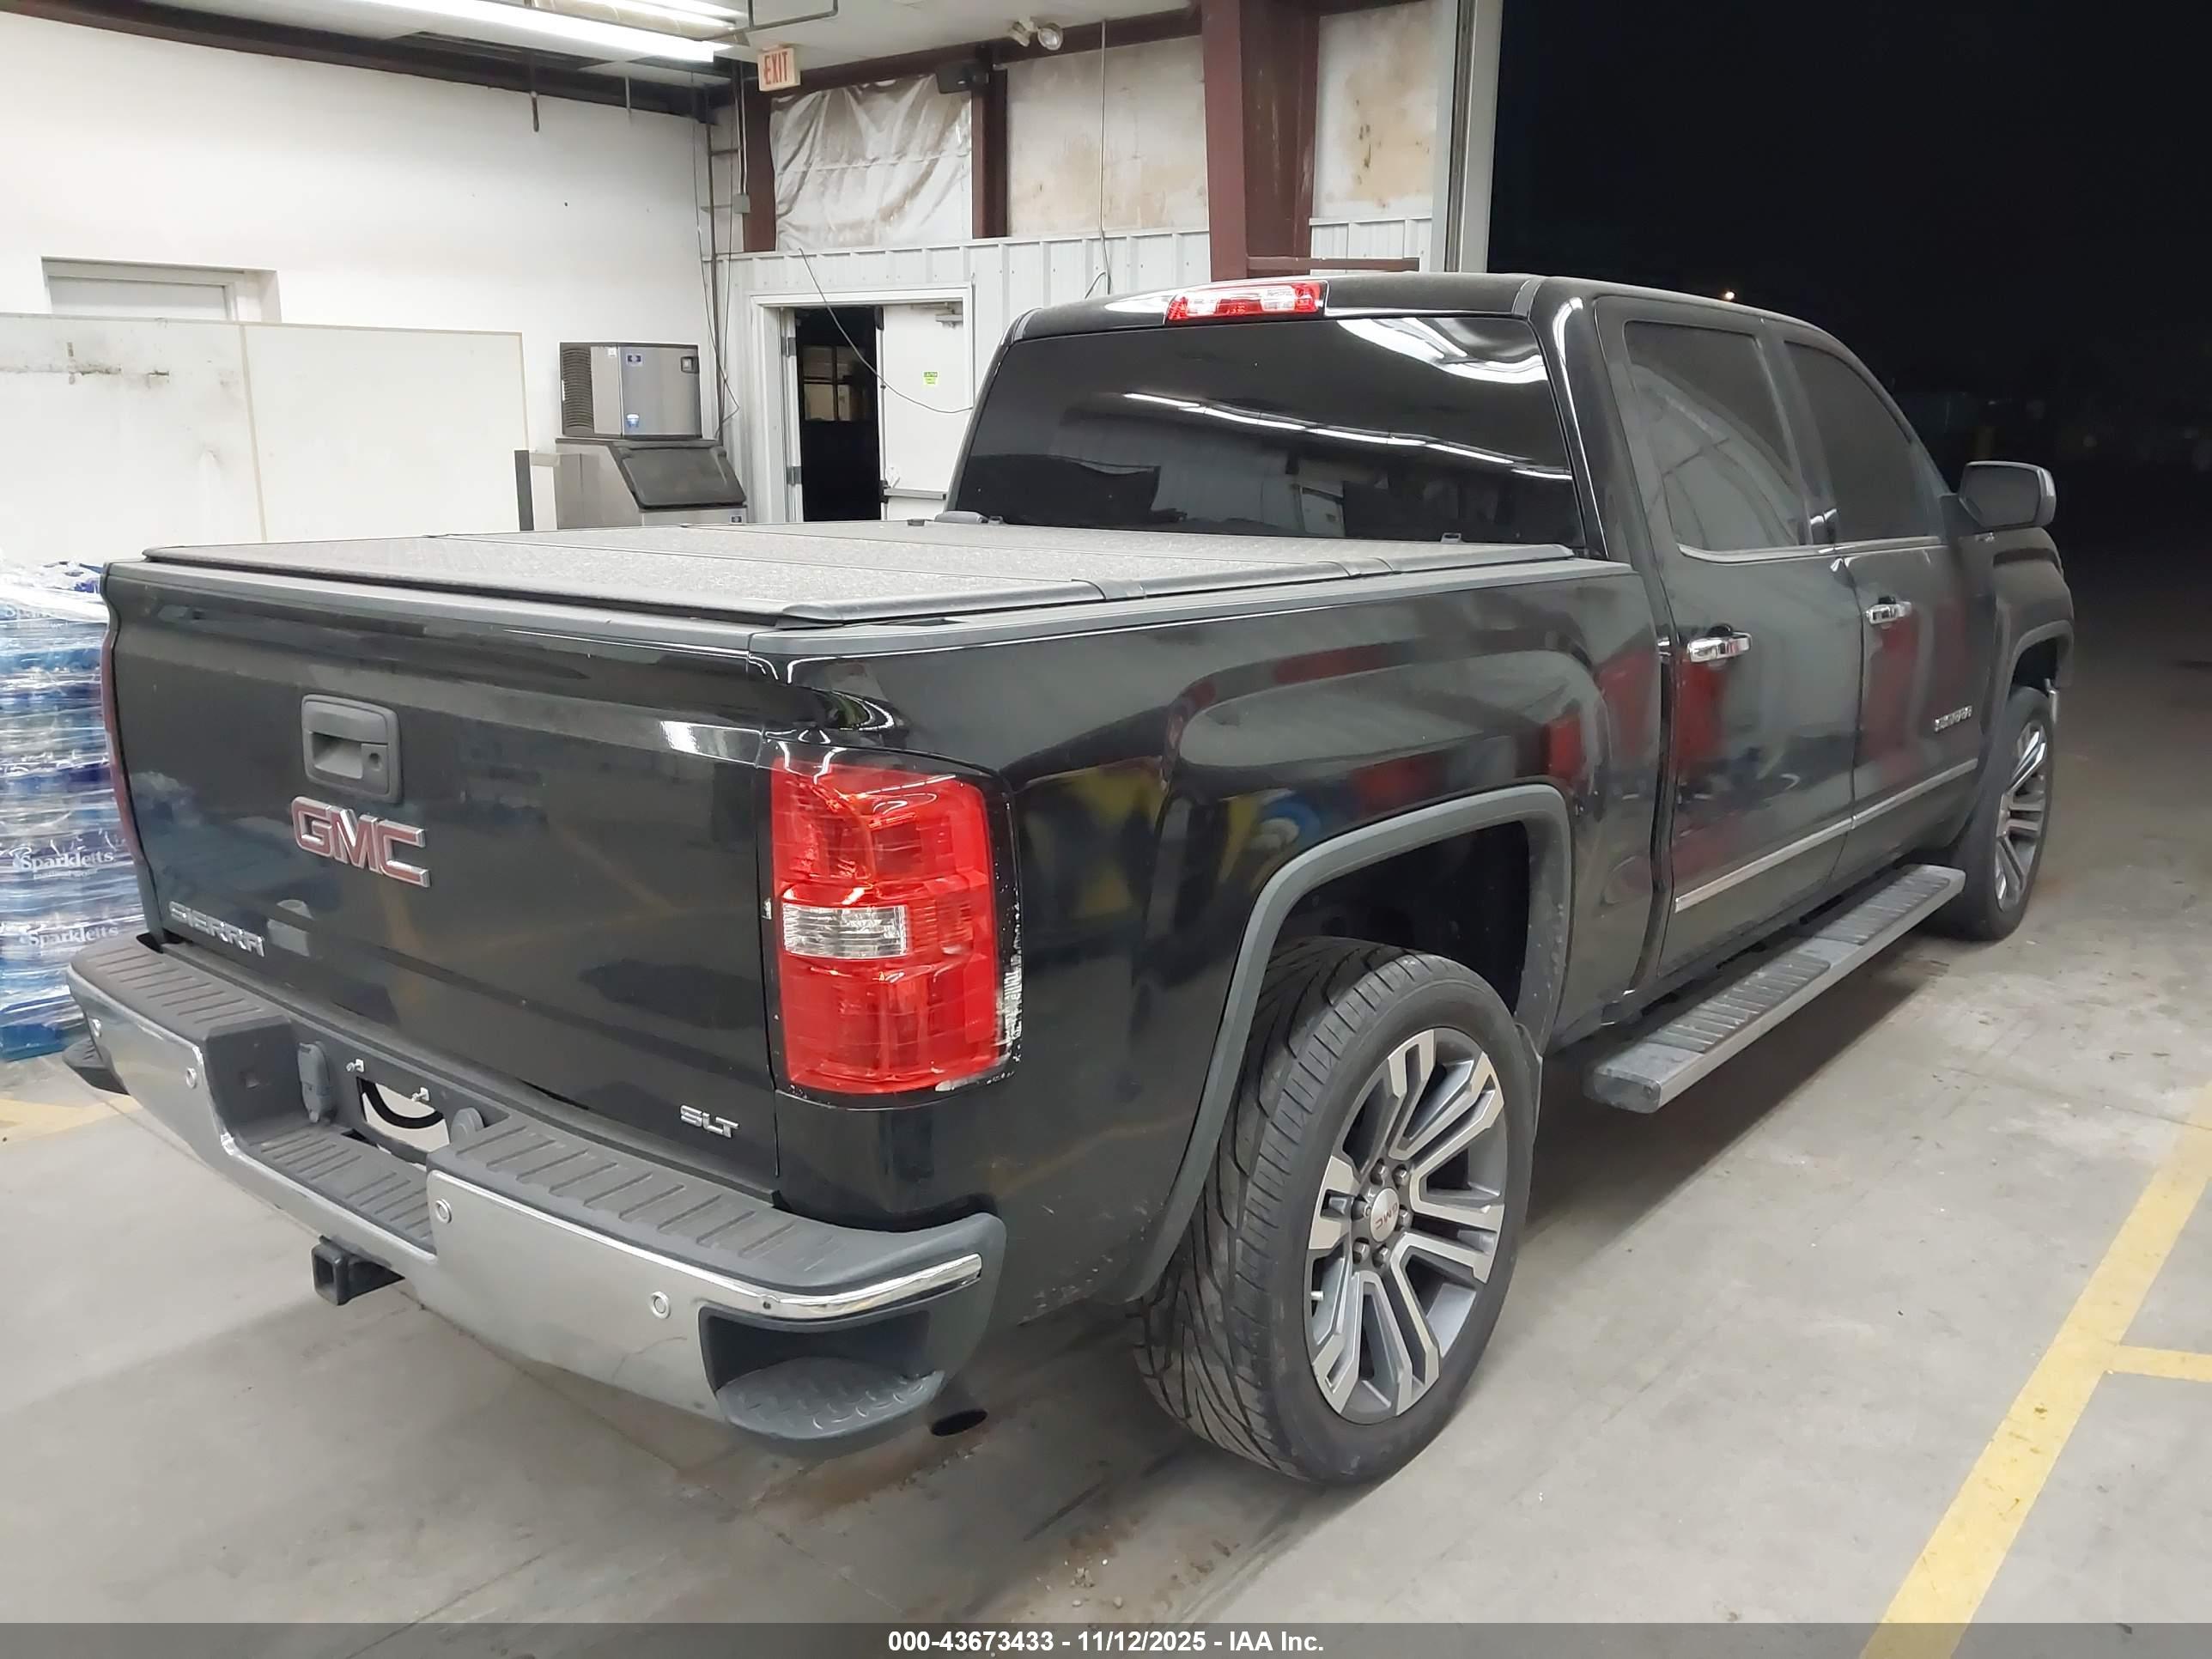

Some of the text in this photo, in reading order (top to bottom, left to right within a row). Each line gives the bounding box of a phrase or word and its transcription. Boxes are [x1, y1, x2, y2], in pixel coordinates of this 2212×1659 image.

[763, 52, 788, 85] EXIT
[291, 796, 431, 888] GMC
[168, 900, 265, 957] SIERRA
[680, 1104, 739, 1139] SLT
